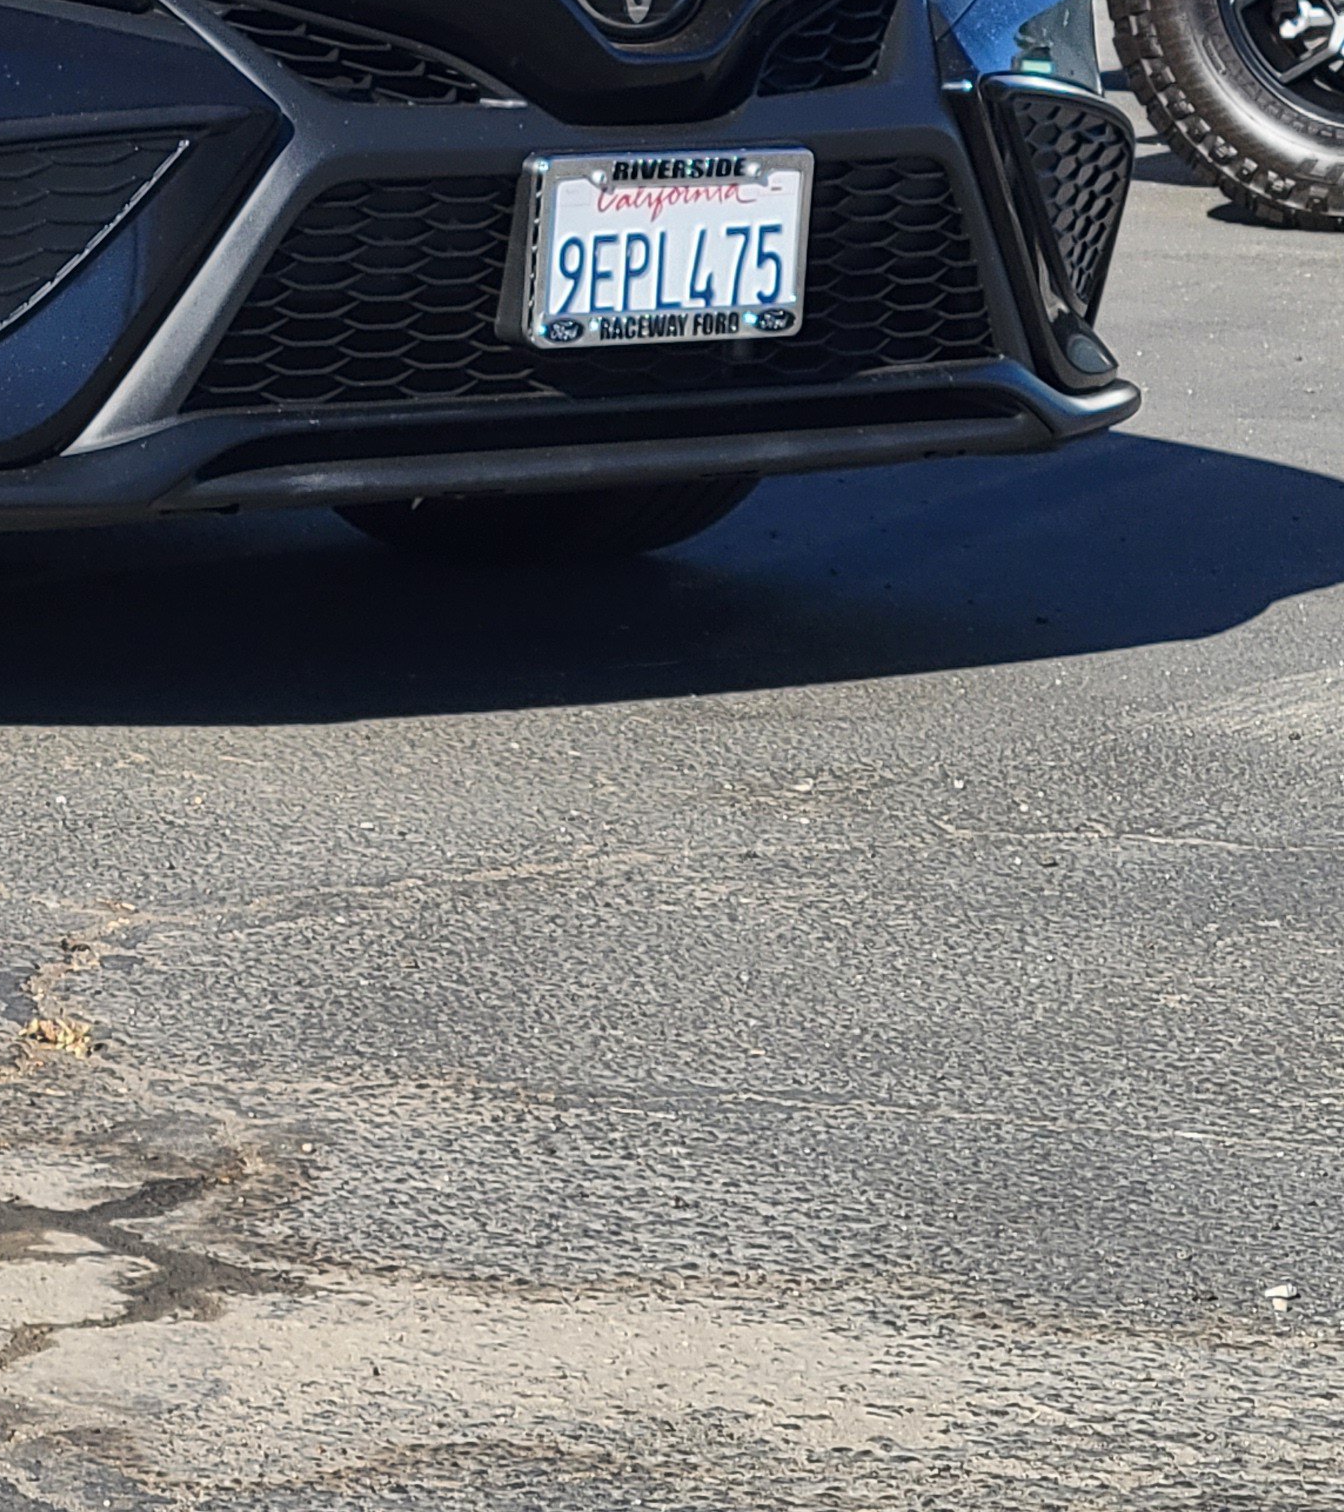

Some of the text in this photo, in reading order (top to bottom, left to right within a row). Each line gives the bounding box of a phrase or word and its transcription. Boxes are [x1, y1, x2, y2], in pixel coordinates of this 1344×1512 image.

[612, 157, 748, 181] RIVERSIDE
[596, 182, 758, 223] California
[557, 223, 783, 314] 9EPL475
[599, 314, 689, 341] RACEWAY
[692, 312, 740, 336] FORD
